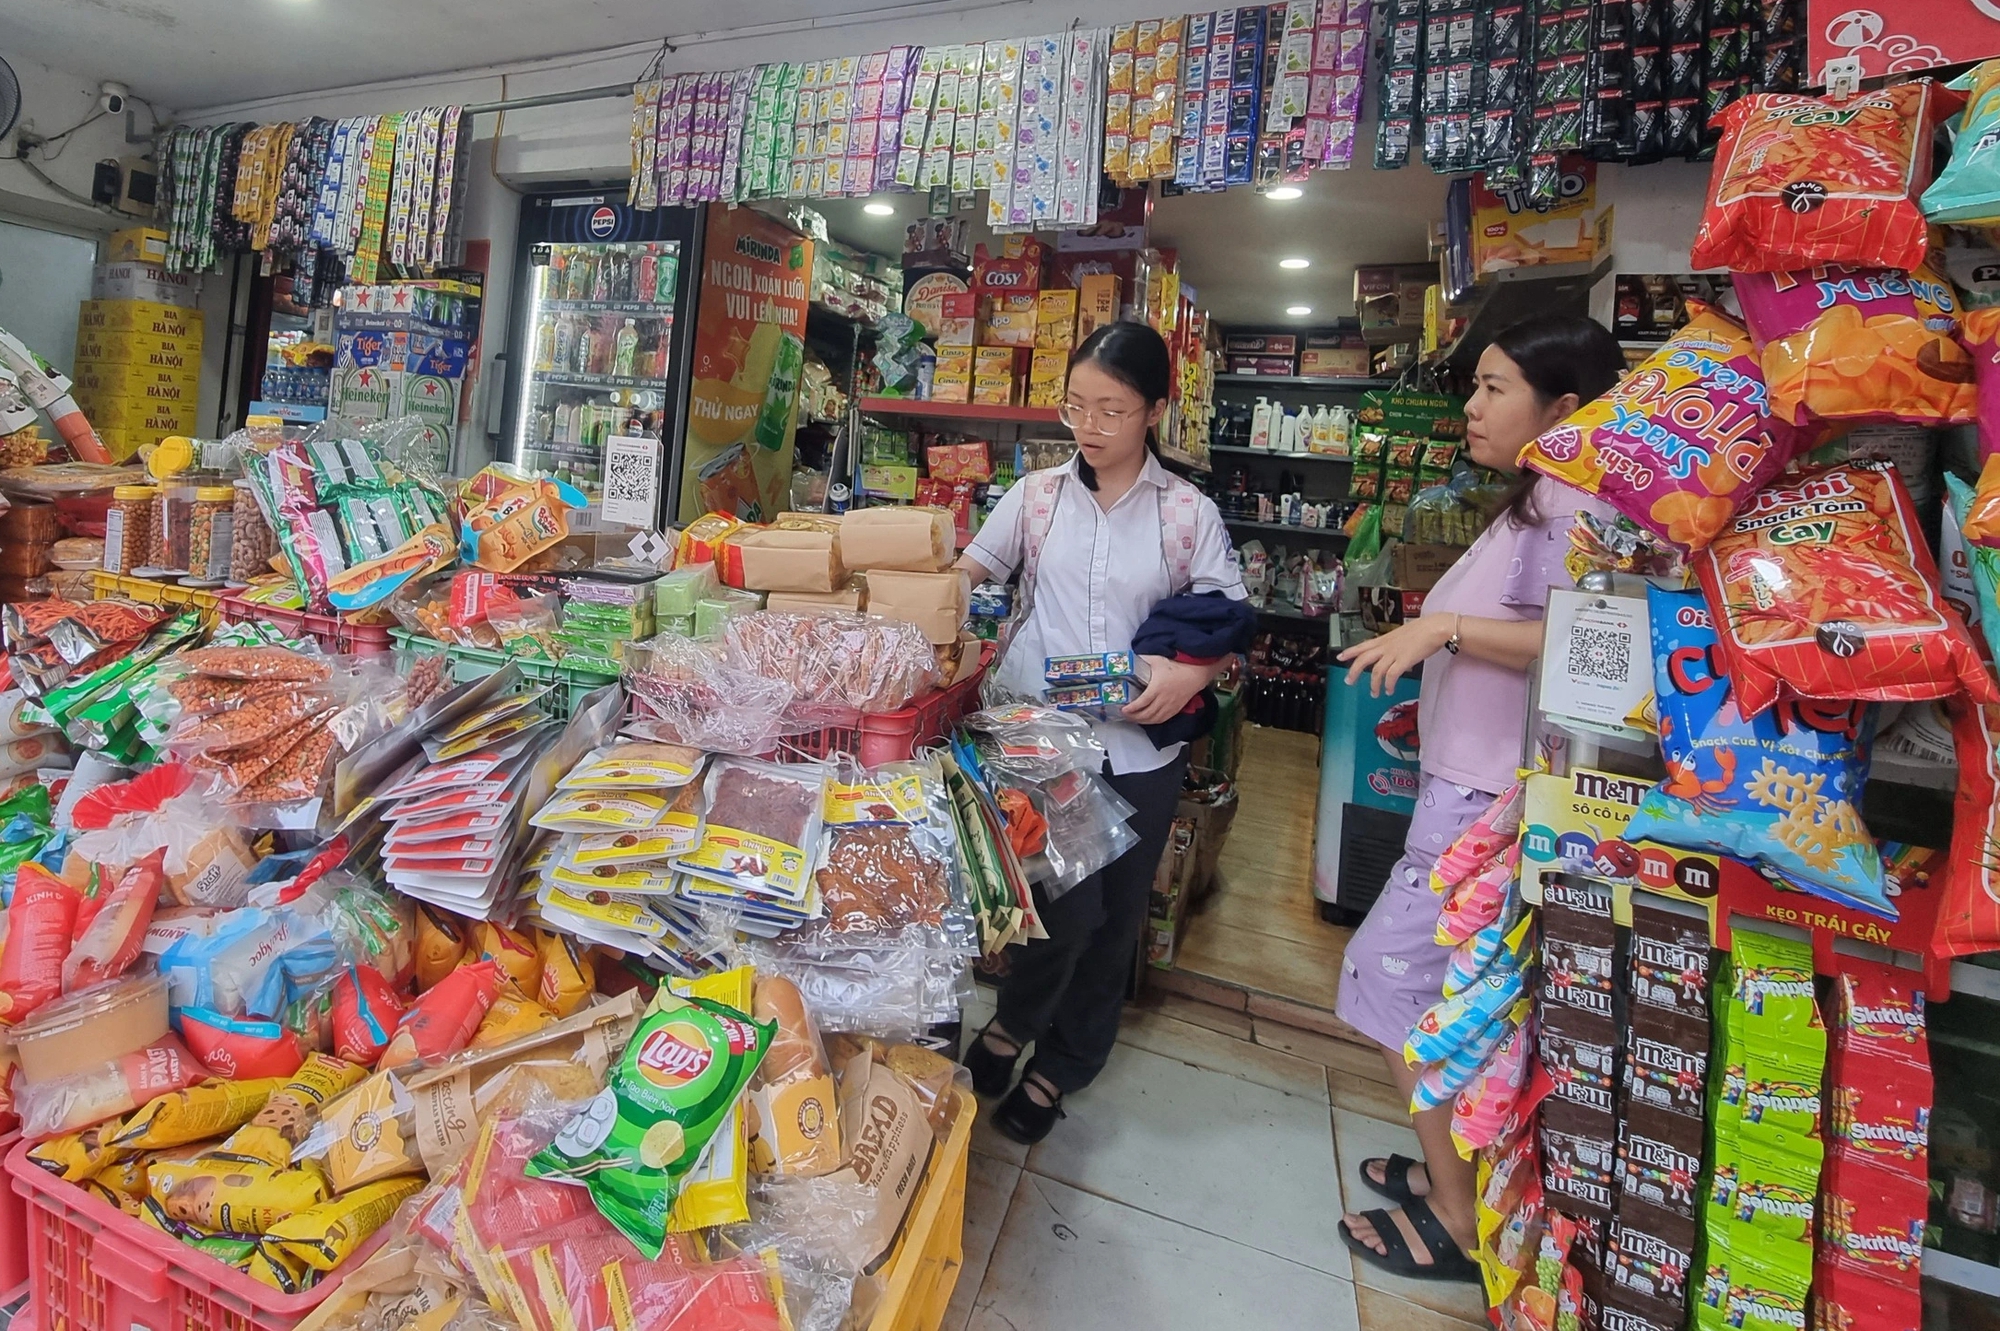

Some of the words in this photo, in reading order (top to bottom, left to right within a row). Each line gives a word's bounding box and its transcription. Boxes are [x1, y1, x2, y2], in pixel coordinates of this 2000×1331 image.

[1495, 172, 1585, 214] Tio
[1791, 181, 1822, 193] RANG
[593, 218, 614, 226] PEPSI
[711, 260, 752, 291] NGON
[985, 271, 1021, 286] COSY
[918, 282, 958, 301] Danisa
[1362, 283, 1390, 291] VIFON
[1010, 295, 1031, 305] Tipo
[163, 310, 178, 320] BIA
[726, 293, 750, 321] VUI
[753, 301, 772, 323] LÊN
[775, 304, 798, 327] NHA!
[152, 321, 166, 334] HÀ
[168, 322, 186, 337] NỘI
[161, 341, 176, 351] BIA
[356, 337, 383, 356] Tiger
[941, 349, 966, 357] Custas
[981, 349, 1006, 357] Custas
[150, 353, 164, 365] HÀ
[165, 354, 183, 368] NỘI
[430, 359, 452, 374] Tiger
[157, 373, 172, 383] BIA
[938, 376, 963, 385] Custas
[979, 378, 1005, 387] Custas
[147, 385, 161, 397] HÀ
[161, 386, 180, 400] NỘI
[341, 386, 391, 403] Heineken
[157, 405, 171, 414] BIA
[407, 400, 453, 415] Heineken
[694, 396, 722, 420] THỬ
[724, 402, 760, 421] NGAY
[1391, 397, 1404, 406] KHO
[1429, 399, 1449, 408] NGON
[145, 416, 159, 428] HÀ
[160, 418, 178, 431] NỘI
[1594, 446, 1654, 491] Oishi
[1735, 506, 1808, 533] Snack
[1810, 500, 1865, 514] Tôm
[1767, 520, 1837, 545] Cay
[1821, 621, 1856, 633] RANG
[1692, 736, 1728, 749] Snack
[1732, 736, 1757, 747] Cua
[1761, 740, 1775, 753] Vị
[1572, 803, 1590, 815] SÔ
[1593, 807, 1611, 819] CÔ
[1615, 812, 1631, 823] LA
[1528, 833, 1551, 854] m
[1594, 855, 1617, 877] m
[1643, 857, 1669, 879] m
[1685, 866, 1711, 889] m
[25, 890, 54, 905] KINH
[1766, 904, 1798, 923] KẸO
[1801, 910, 1847, 933] TRÁI
[1852, 922, 1892, 943] CÂY
[1746, 979, 1815, 998] Skittles
[1851, 1006, 1926, 1027] Skittles
[640, 1031, 709, 1077] Lay's
[659, 1100, 678, 1116] Nori
[1747, 1092, 1821, 1114] Skittles
[851, 1095, 898, 1185] BREAD
[1850, 1122, 1928, 1147] Skittles
[894, 1175, 908, 1200] FRESH
[906, 1152, 917, 1177] DAILY
[1739, 1191, 1815, 1220] Skittles
[1846, 1233, 1922, 1258] Skittles
[1729, 1296, 1806, 1328] Skittles
